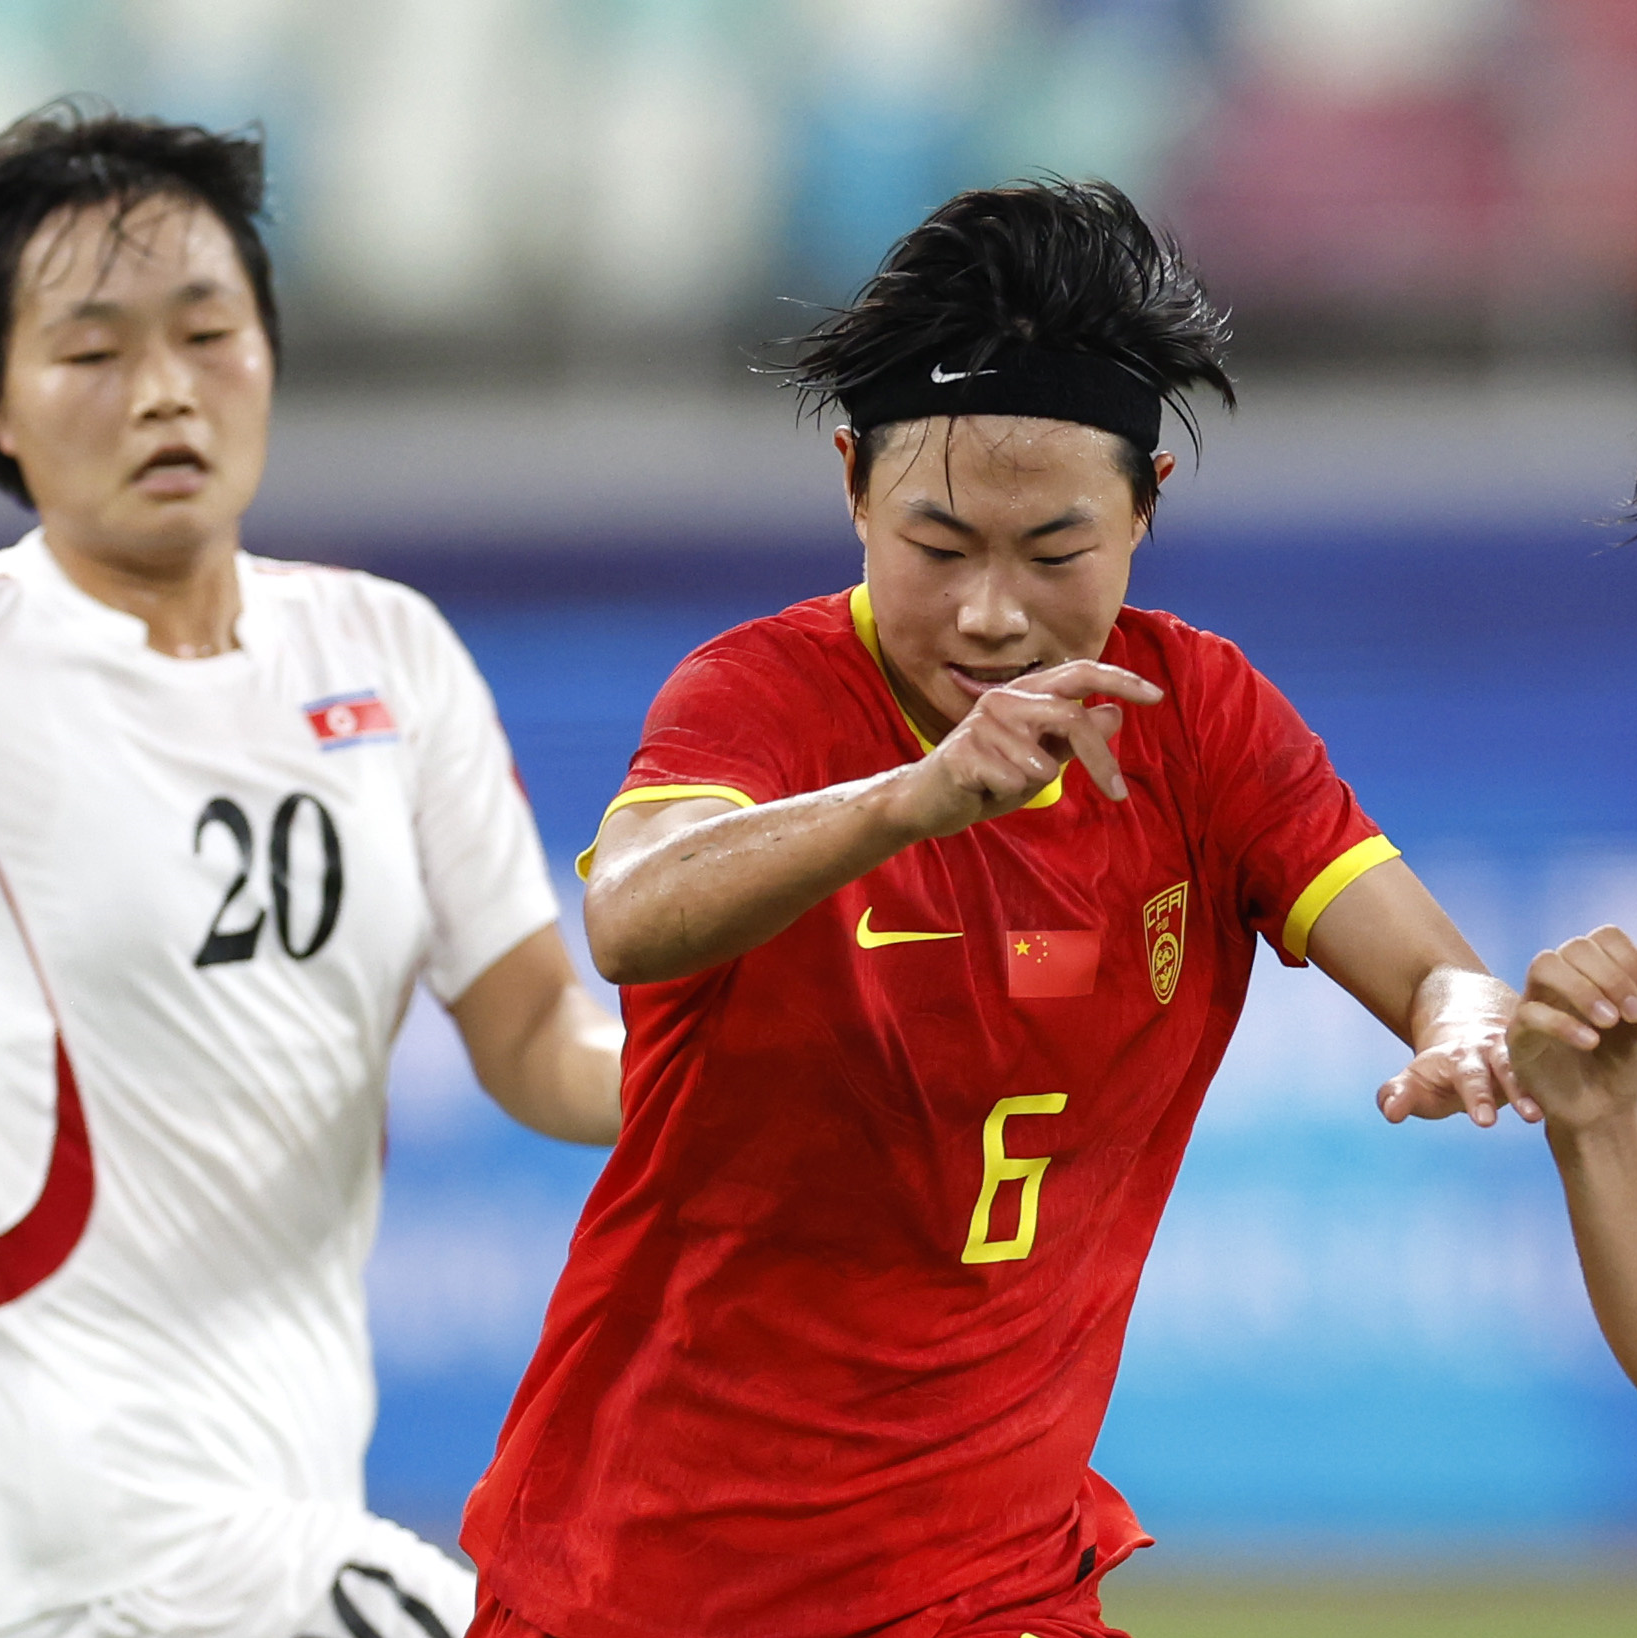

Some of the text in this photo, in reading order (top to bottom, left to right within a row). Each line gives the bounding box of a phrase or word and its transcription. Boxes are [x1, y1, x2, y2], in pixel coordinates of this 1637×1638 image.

[193, 792, 343, 967] 20
[1146, 889, 1183, 929] CFA
[961, 1092, 1069, 1264] 6
